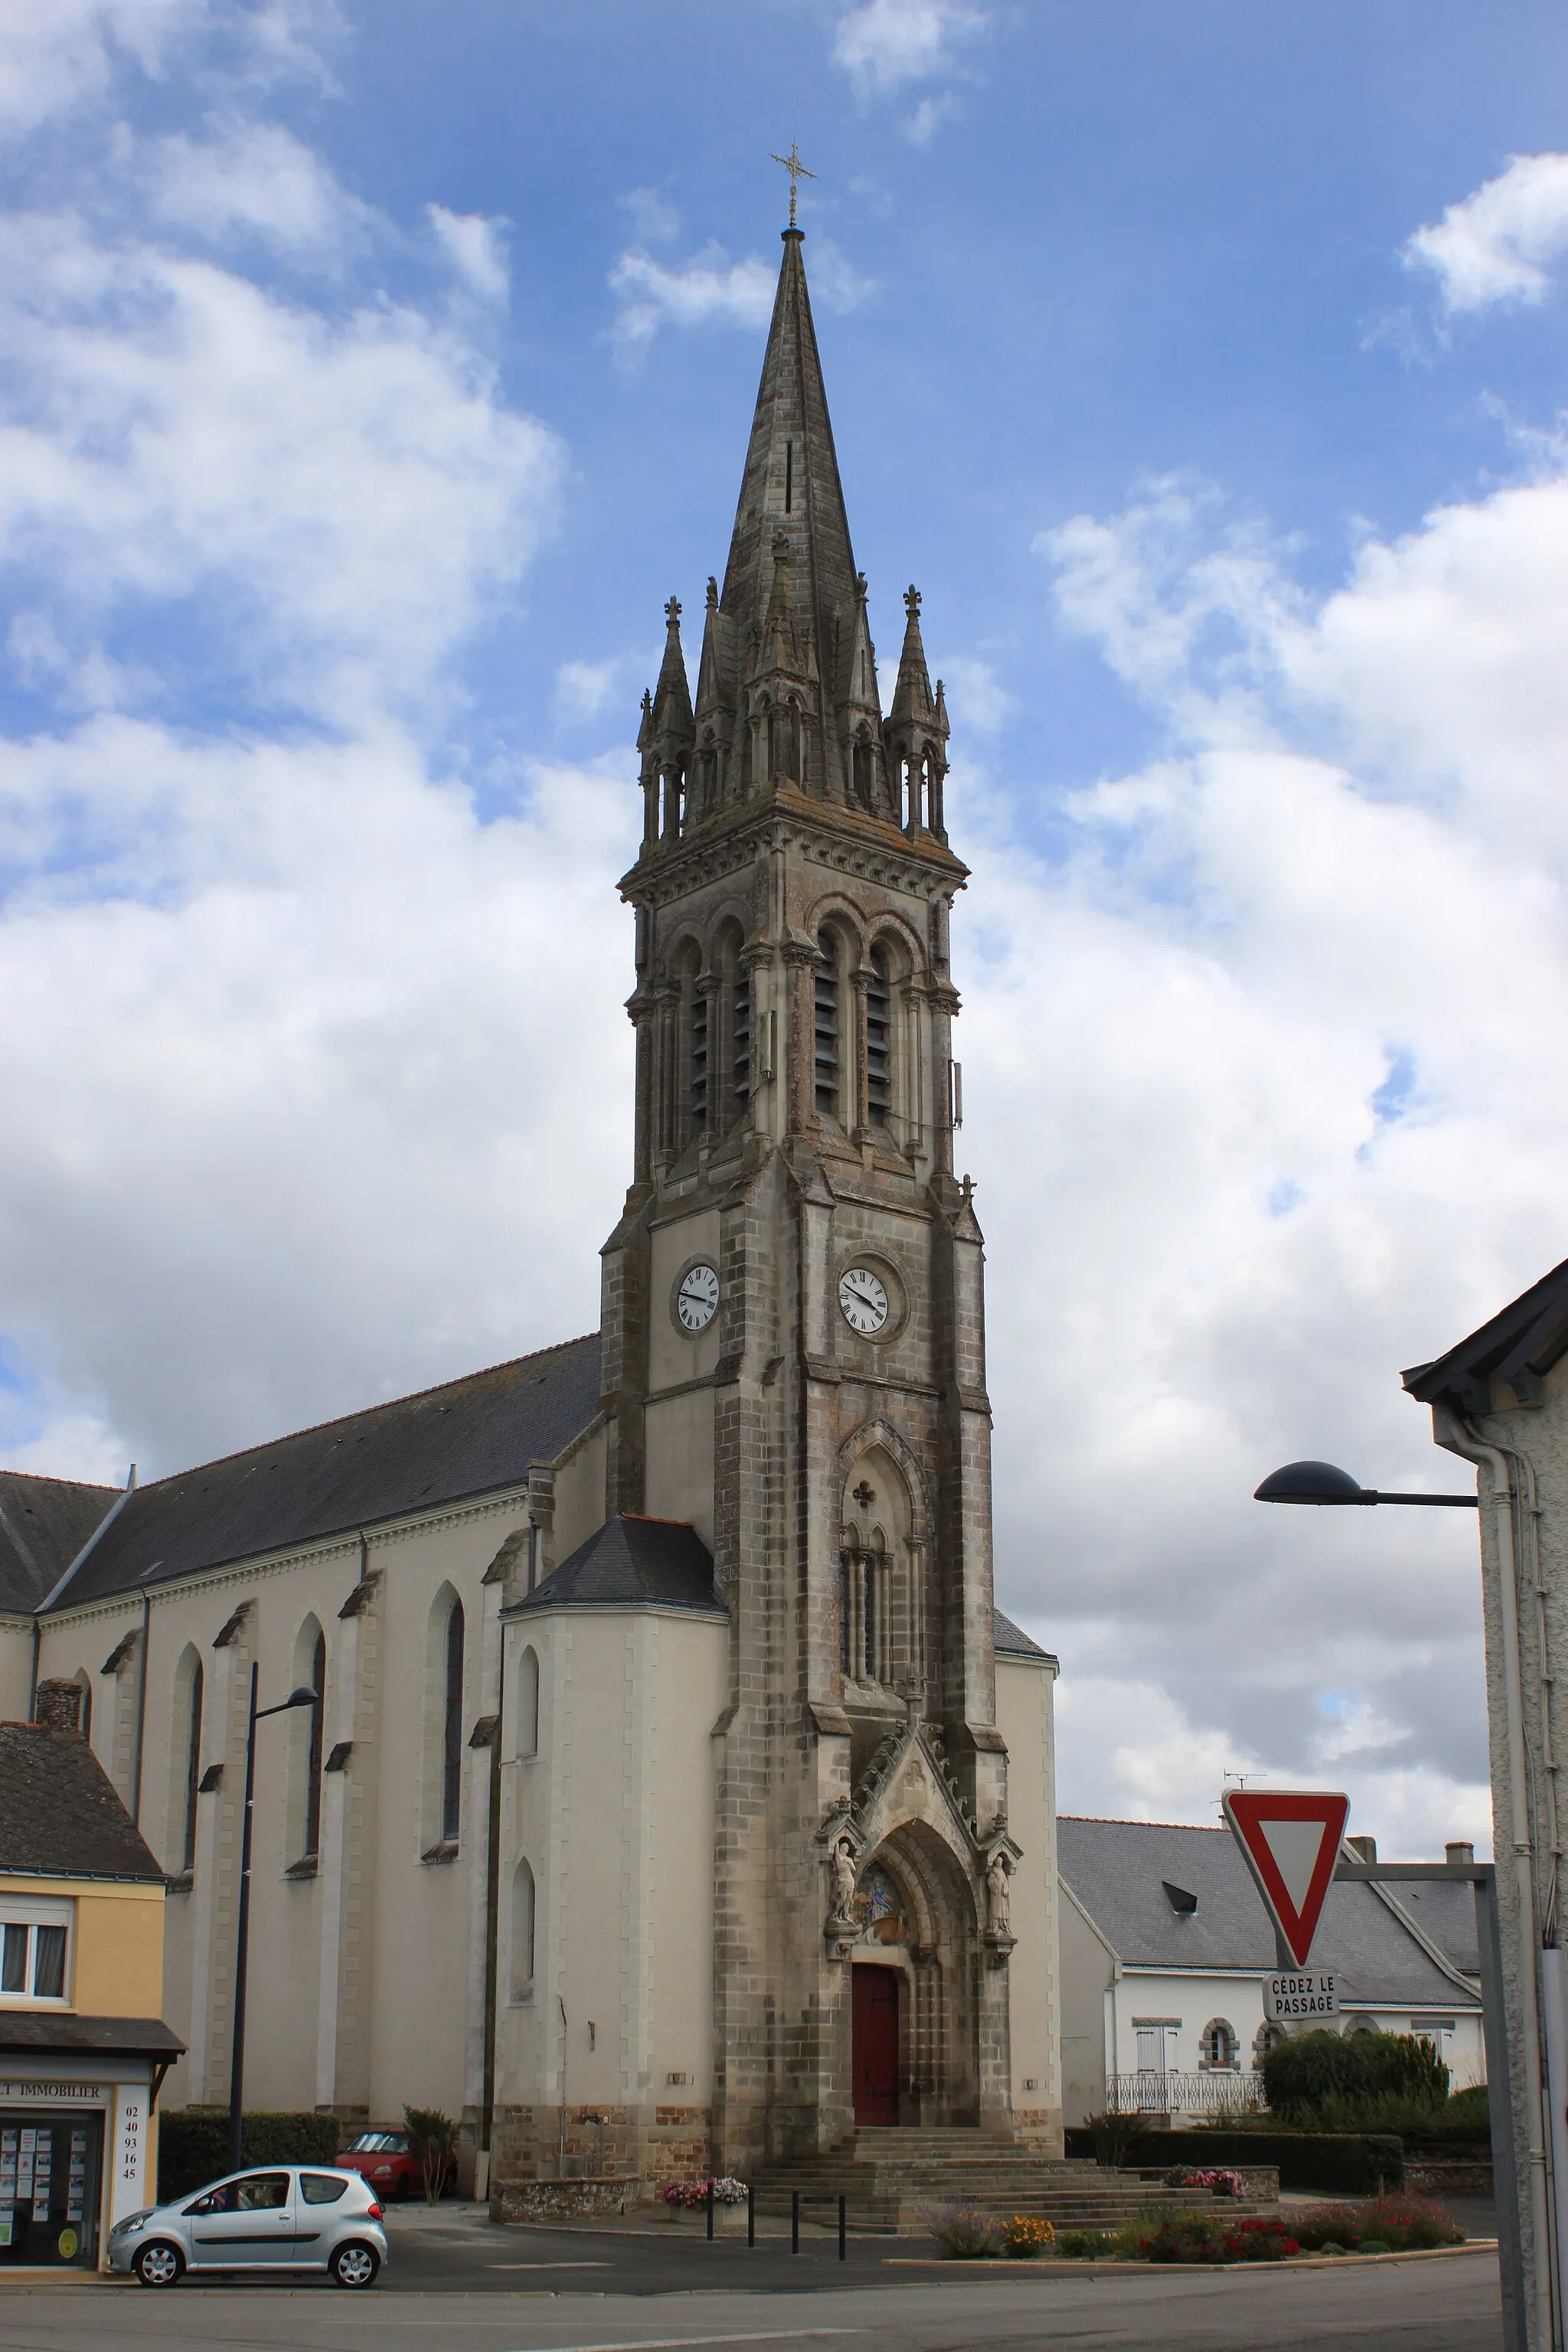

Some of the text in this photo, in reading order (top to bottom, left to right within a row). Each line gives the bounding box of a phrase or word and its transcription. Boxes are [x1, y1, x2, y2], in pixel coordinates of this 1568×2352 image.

[1272, 1976, 1334, 1994] CÉDEZ LE
[1276, 1996, 1333, 2014] PASSAGE
[20, 2083, 100, 2098] IMMOBILIER
[126, 2107, 138, 2117] 02
[125, 2122, 138, 2132] 40
[125, 2138, 137, 2148] 93
[125, 2154, 136, 2164] 16
[122, 2169, 136, 2179] 45
